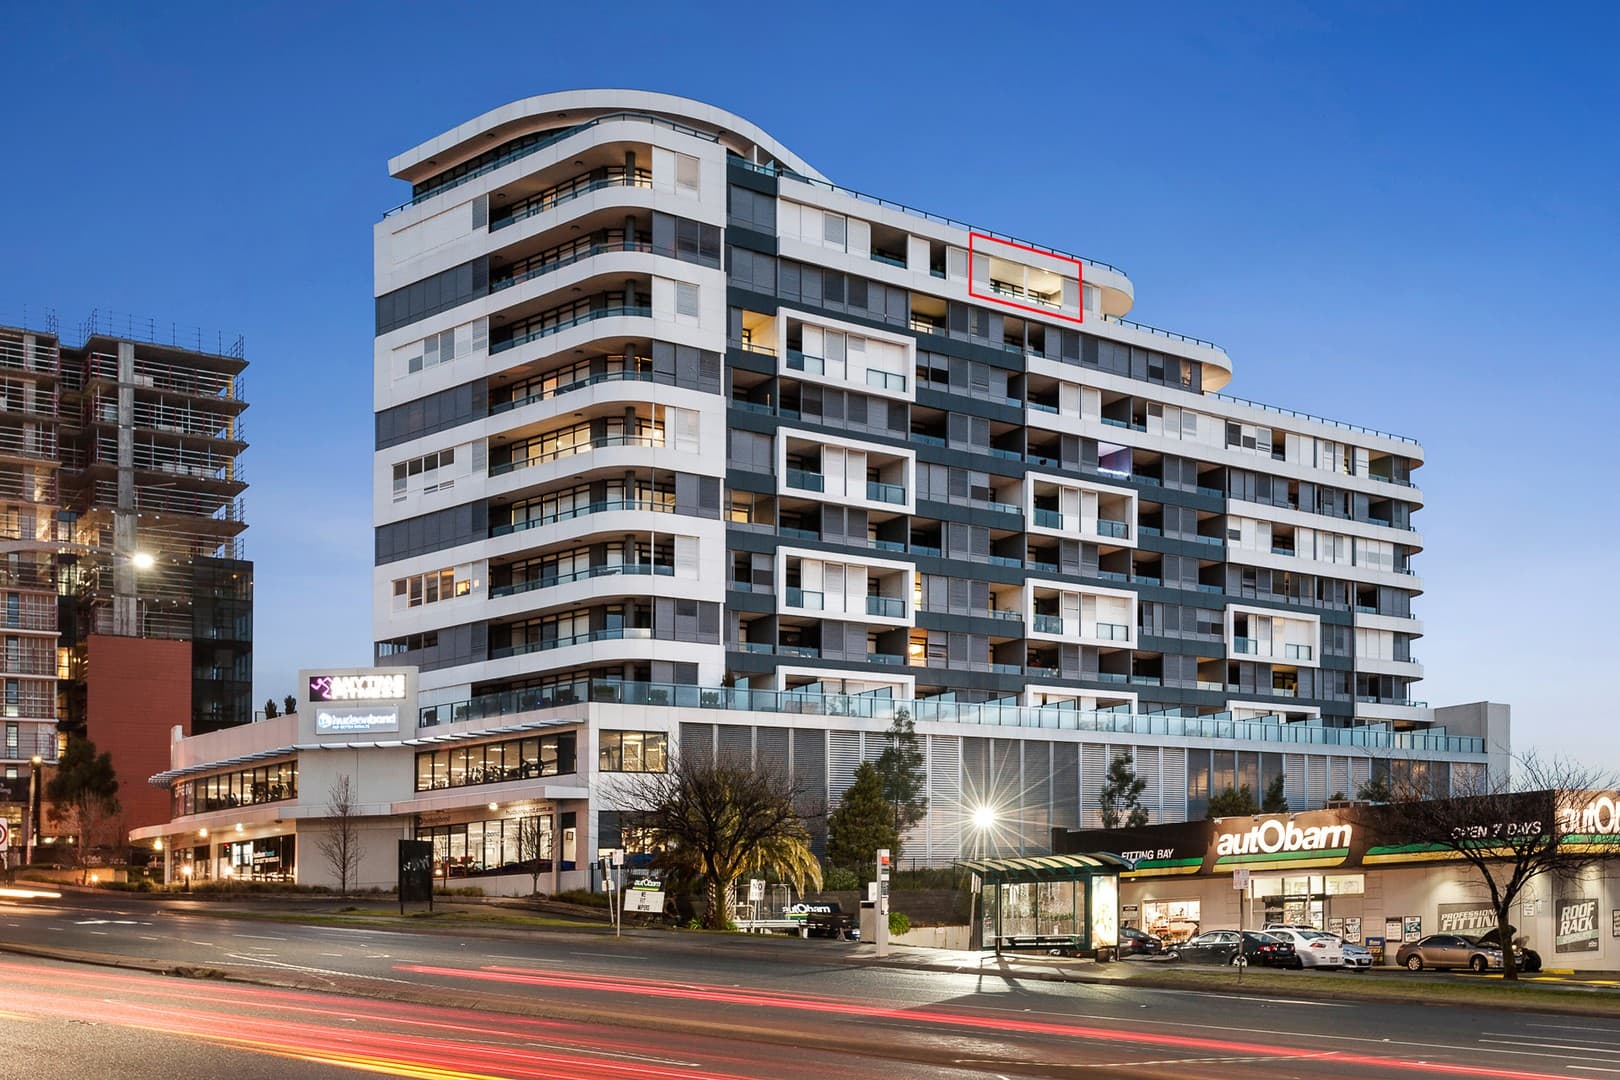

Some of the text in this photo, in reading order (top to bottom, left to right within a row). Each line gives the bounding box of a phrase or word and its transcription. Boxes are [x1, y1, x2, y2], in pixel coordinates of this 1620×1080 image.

[1507, 821, 1542, 836] DAYS
[1121, 848, 1174, 860] FITTING BAY
[1441, 909, 1497, 920] PROFESSION
[1561, 902, 1595, 922] ROOF
[1560, 915, 1594, 936] RACK
